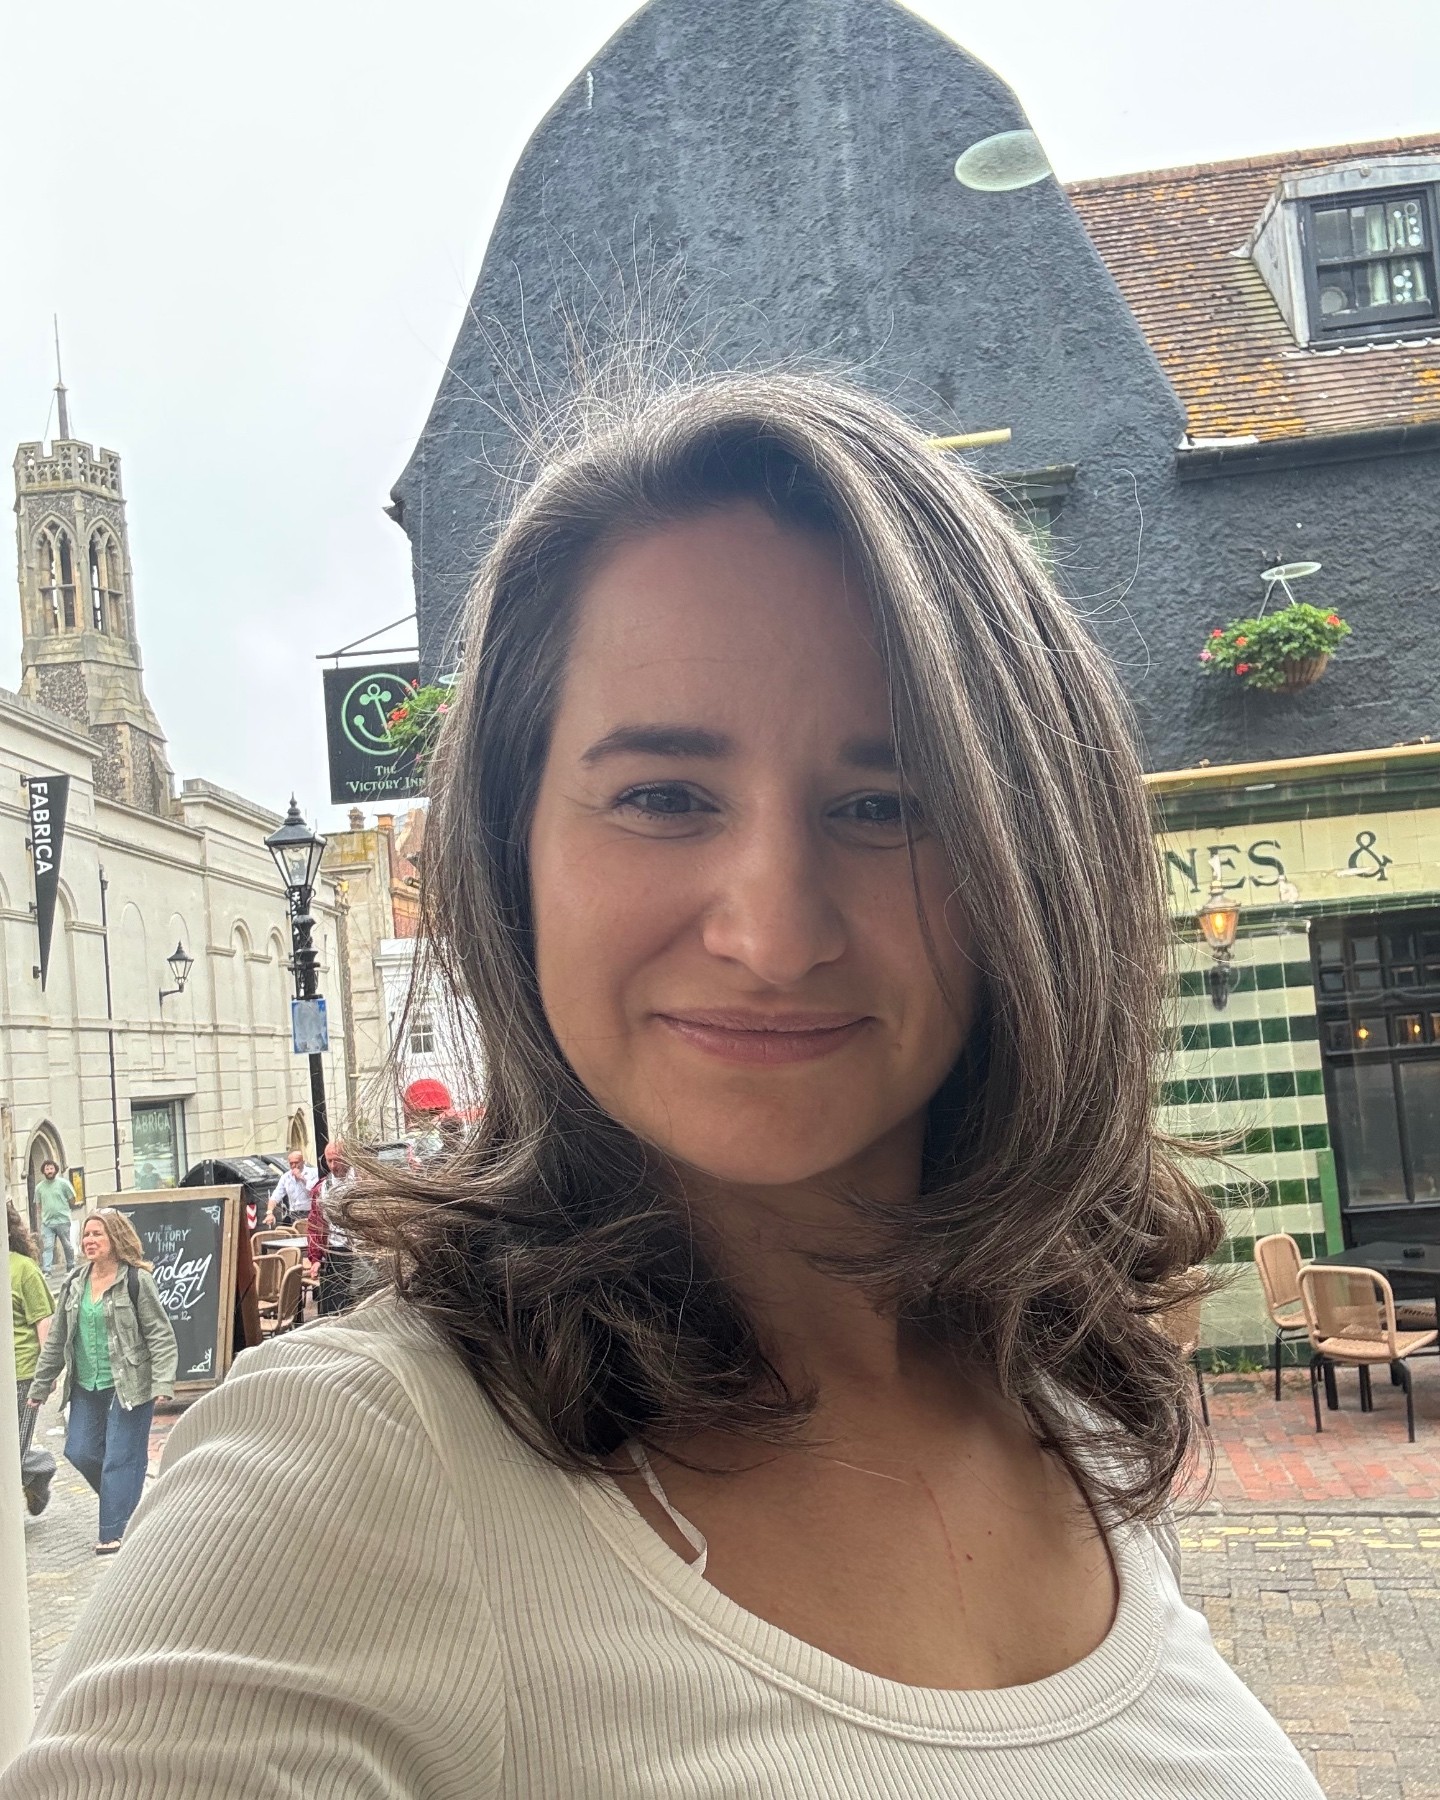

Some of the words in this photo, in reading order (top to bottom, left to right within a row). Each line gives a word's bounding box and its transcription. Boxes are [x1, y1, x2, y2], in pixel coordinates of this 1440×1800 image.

[374, 765, 397, 776] THE
[346, 777, 403, 793] VICTORY
[402, 776, 426, 791] INN
[31, 782, 53, 875] FABRICA
[1348, 830, 1393, 881] &
[132, 1111, 171, 1132] ABRICA
